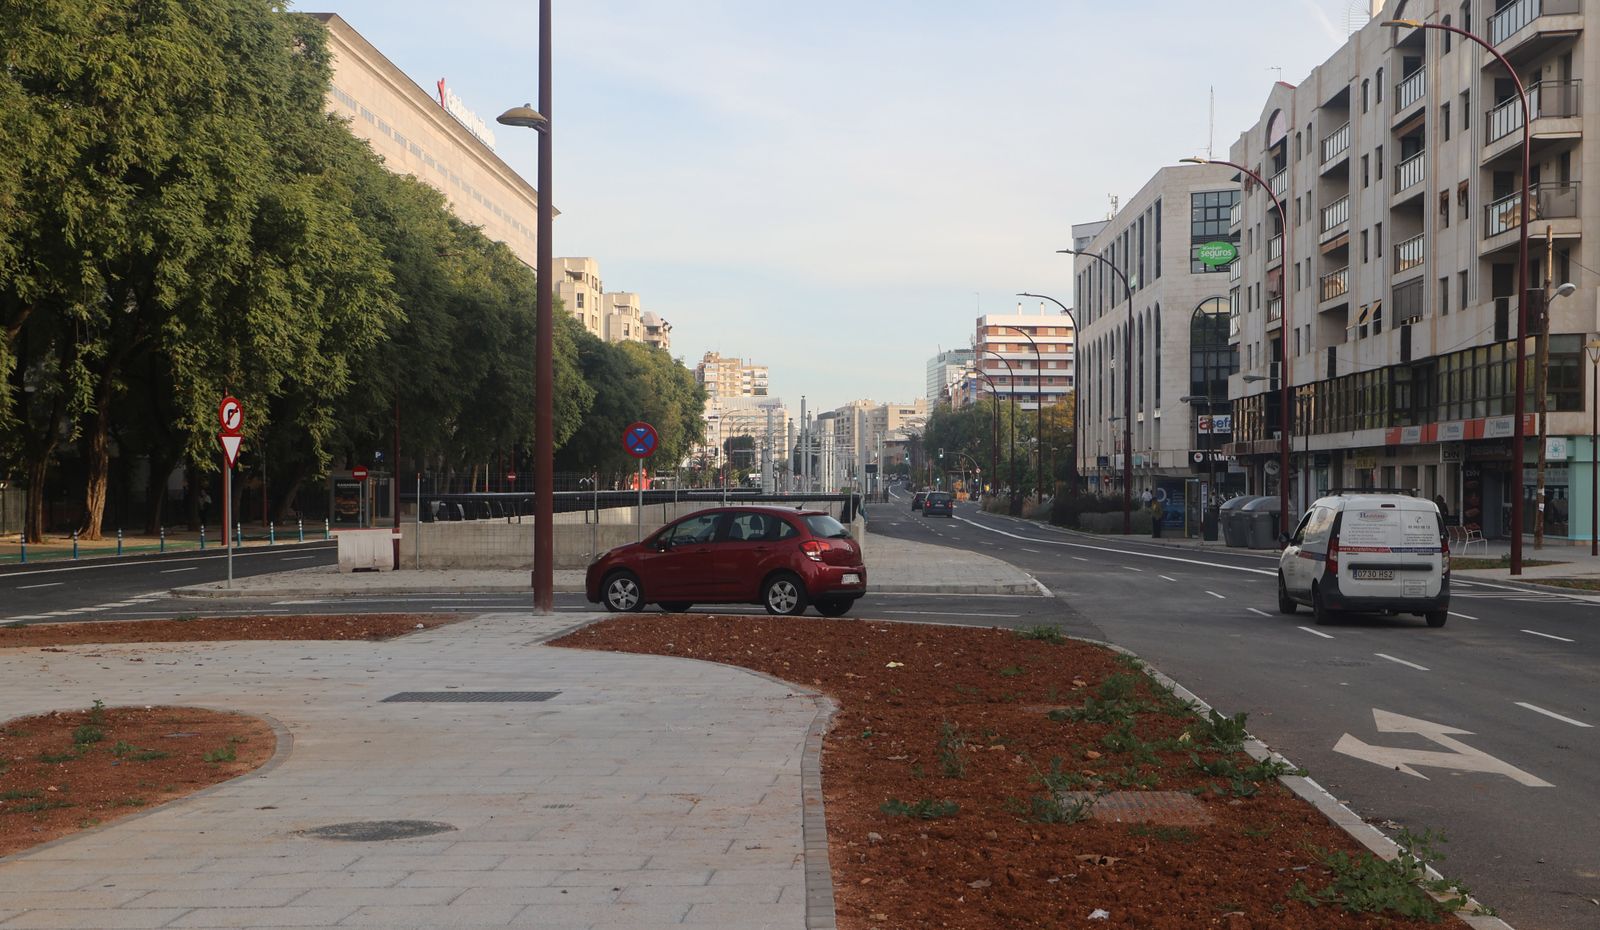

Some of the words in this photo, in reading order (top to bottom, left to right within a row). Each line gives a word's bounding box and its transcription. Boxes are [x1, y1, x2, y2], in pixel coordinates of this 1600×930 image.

[1200, 249, 1232, 259] seguros
[1358, 570, 1377, 578] 0730
[1379, 570, 1393, 578] HSZ
